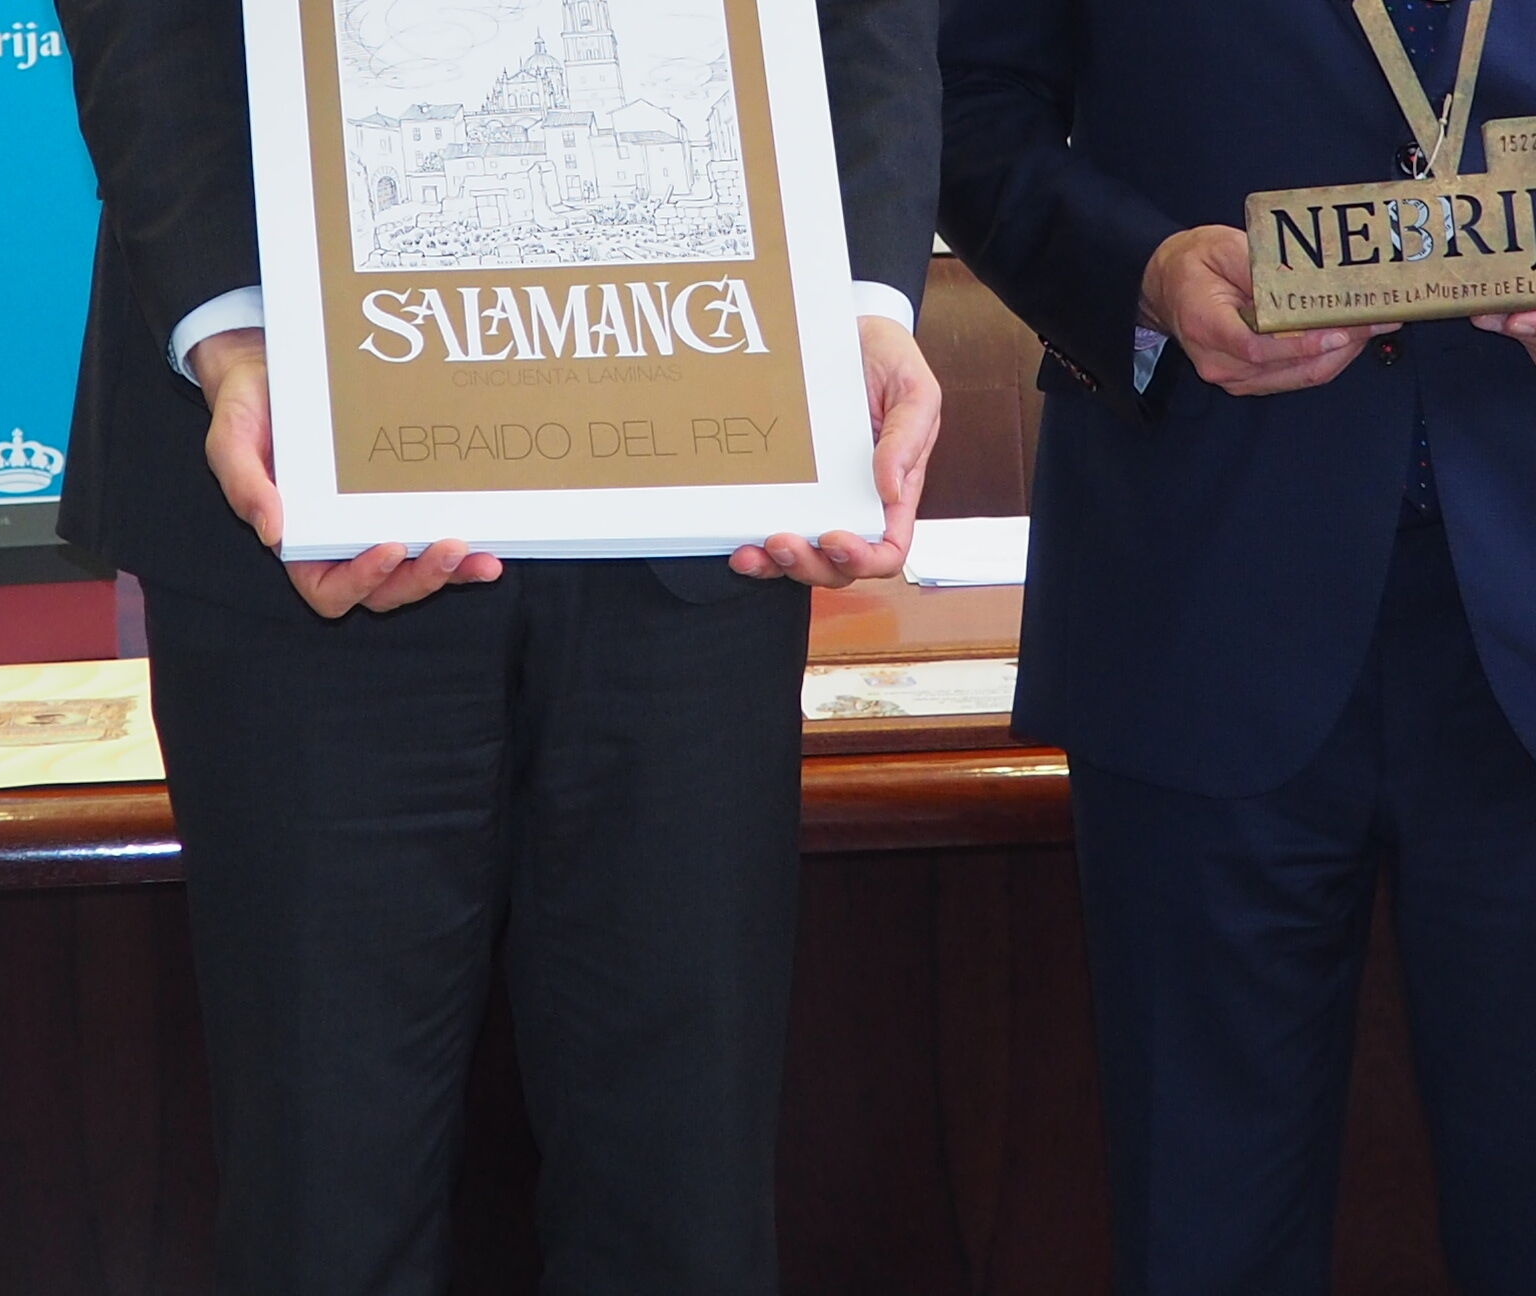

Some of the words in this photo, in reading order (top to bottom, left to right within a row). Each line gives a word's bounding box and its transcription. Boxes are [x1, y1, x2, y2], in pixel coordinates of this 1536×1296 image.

[1383, 289, 1400, 306] DE
[1494, 280, 1511, 296] DE
[358, 274, 770, 364] SALAMANCA
[451, 367, 581, 389] CINCUENTA
[586, 362, 683, 385] LAMINAS
[367, 421, 572, 463] ABRAIDO
[588, 419, 678, 458] DEL
[690, 416, 779, 456] REY
